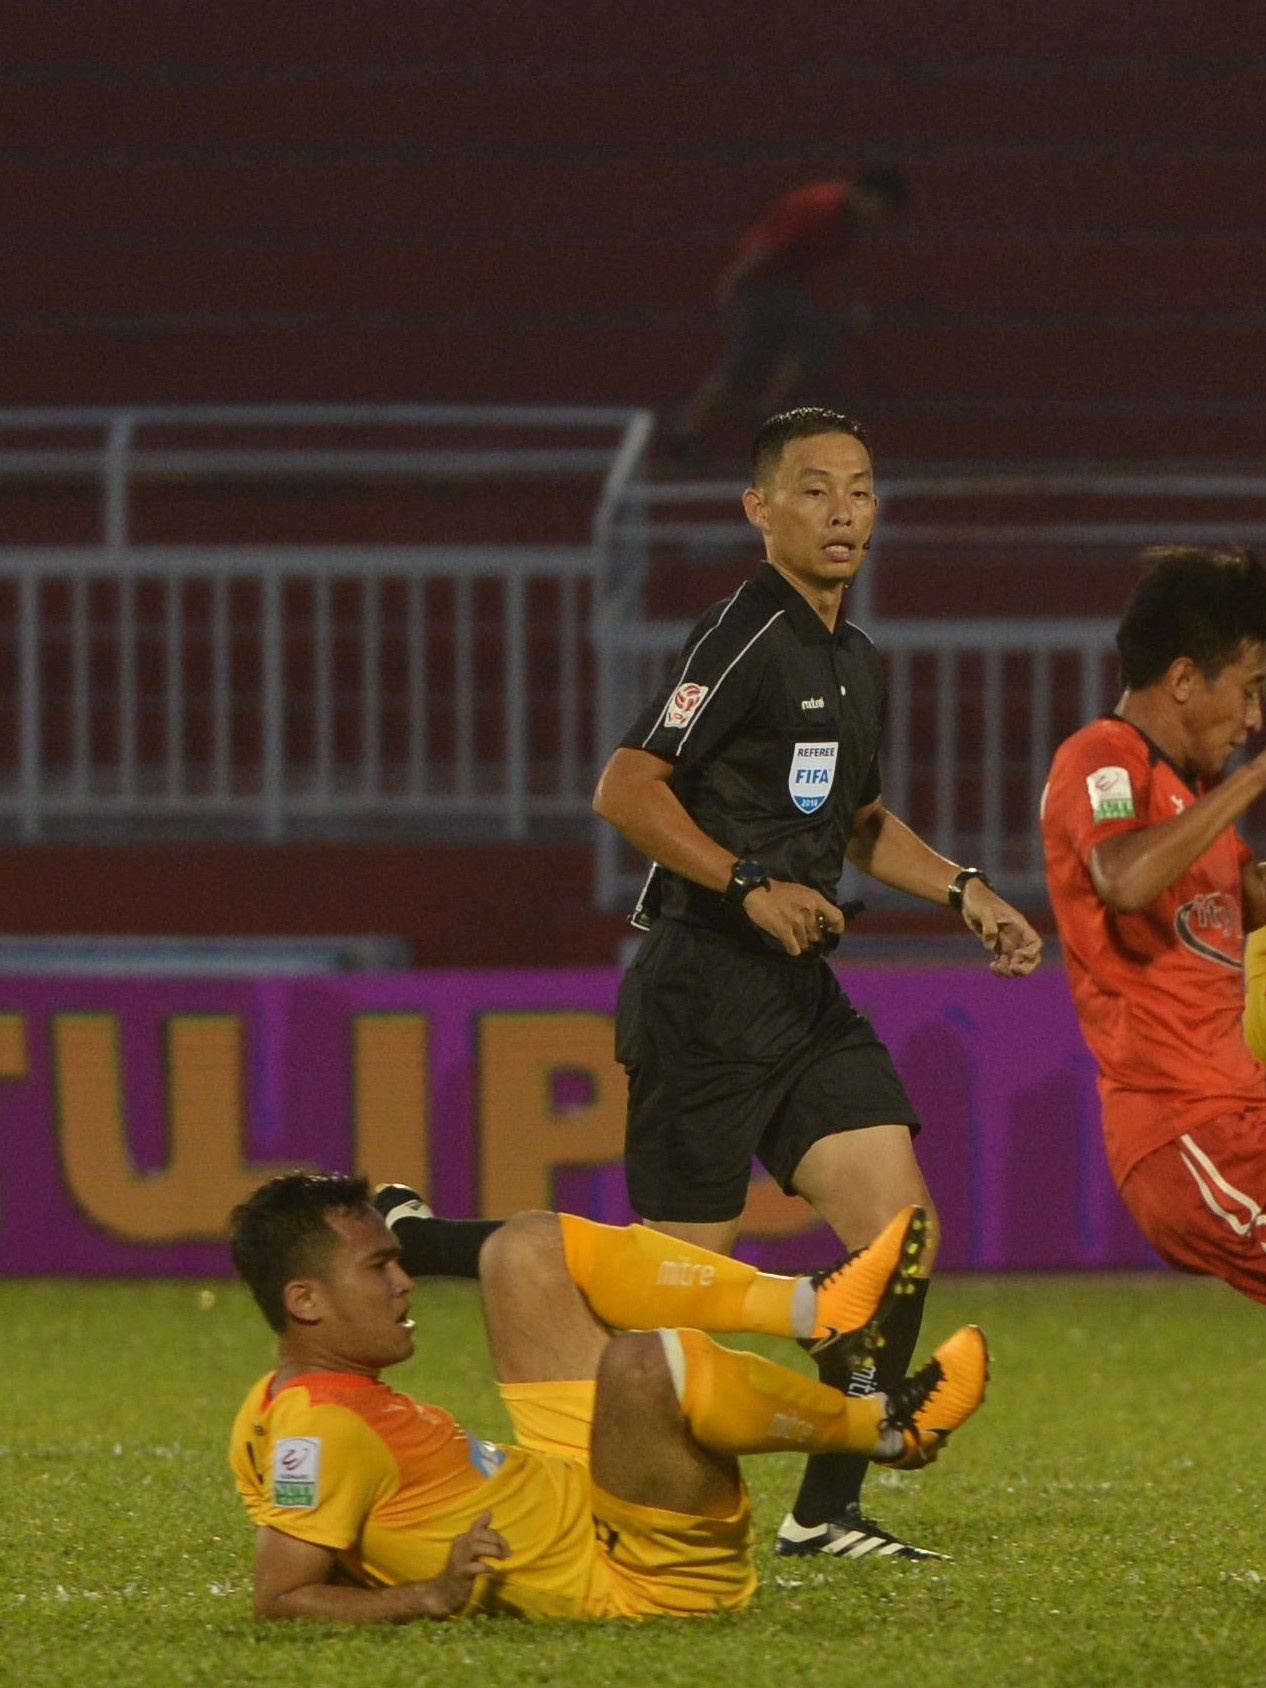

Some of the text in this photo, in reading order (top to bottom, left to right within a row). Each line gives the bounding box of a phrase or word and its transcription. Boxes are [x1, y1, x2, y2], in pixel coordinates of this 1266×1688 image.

[797, 747, 836, 757] REFEREE
[795, 769, 829, 784] FIFA
[656, 1255, 717, 1287] mitre
